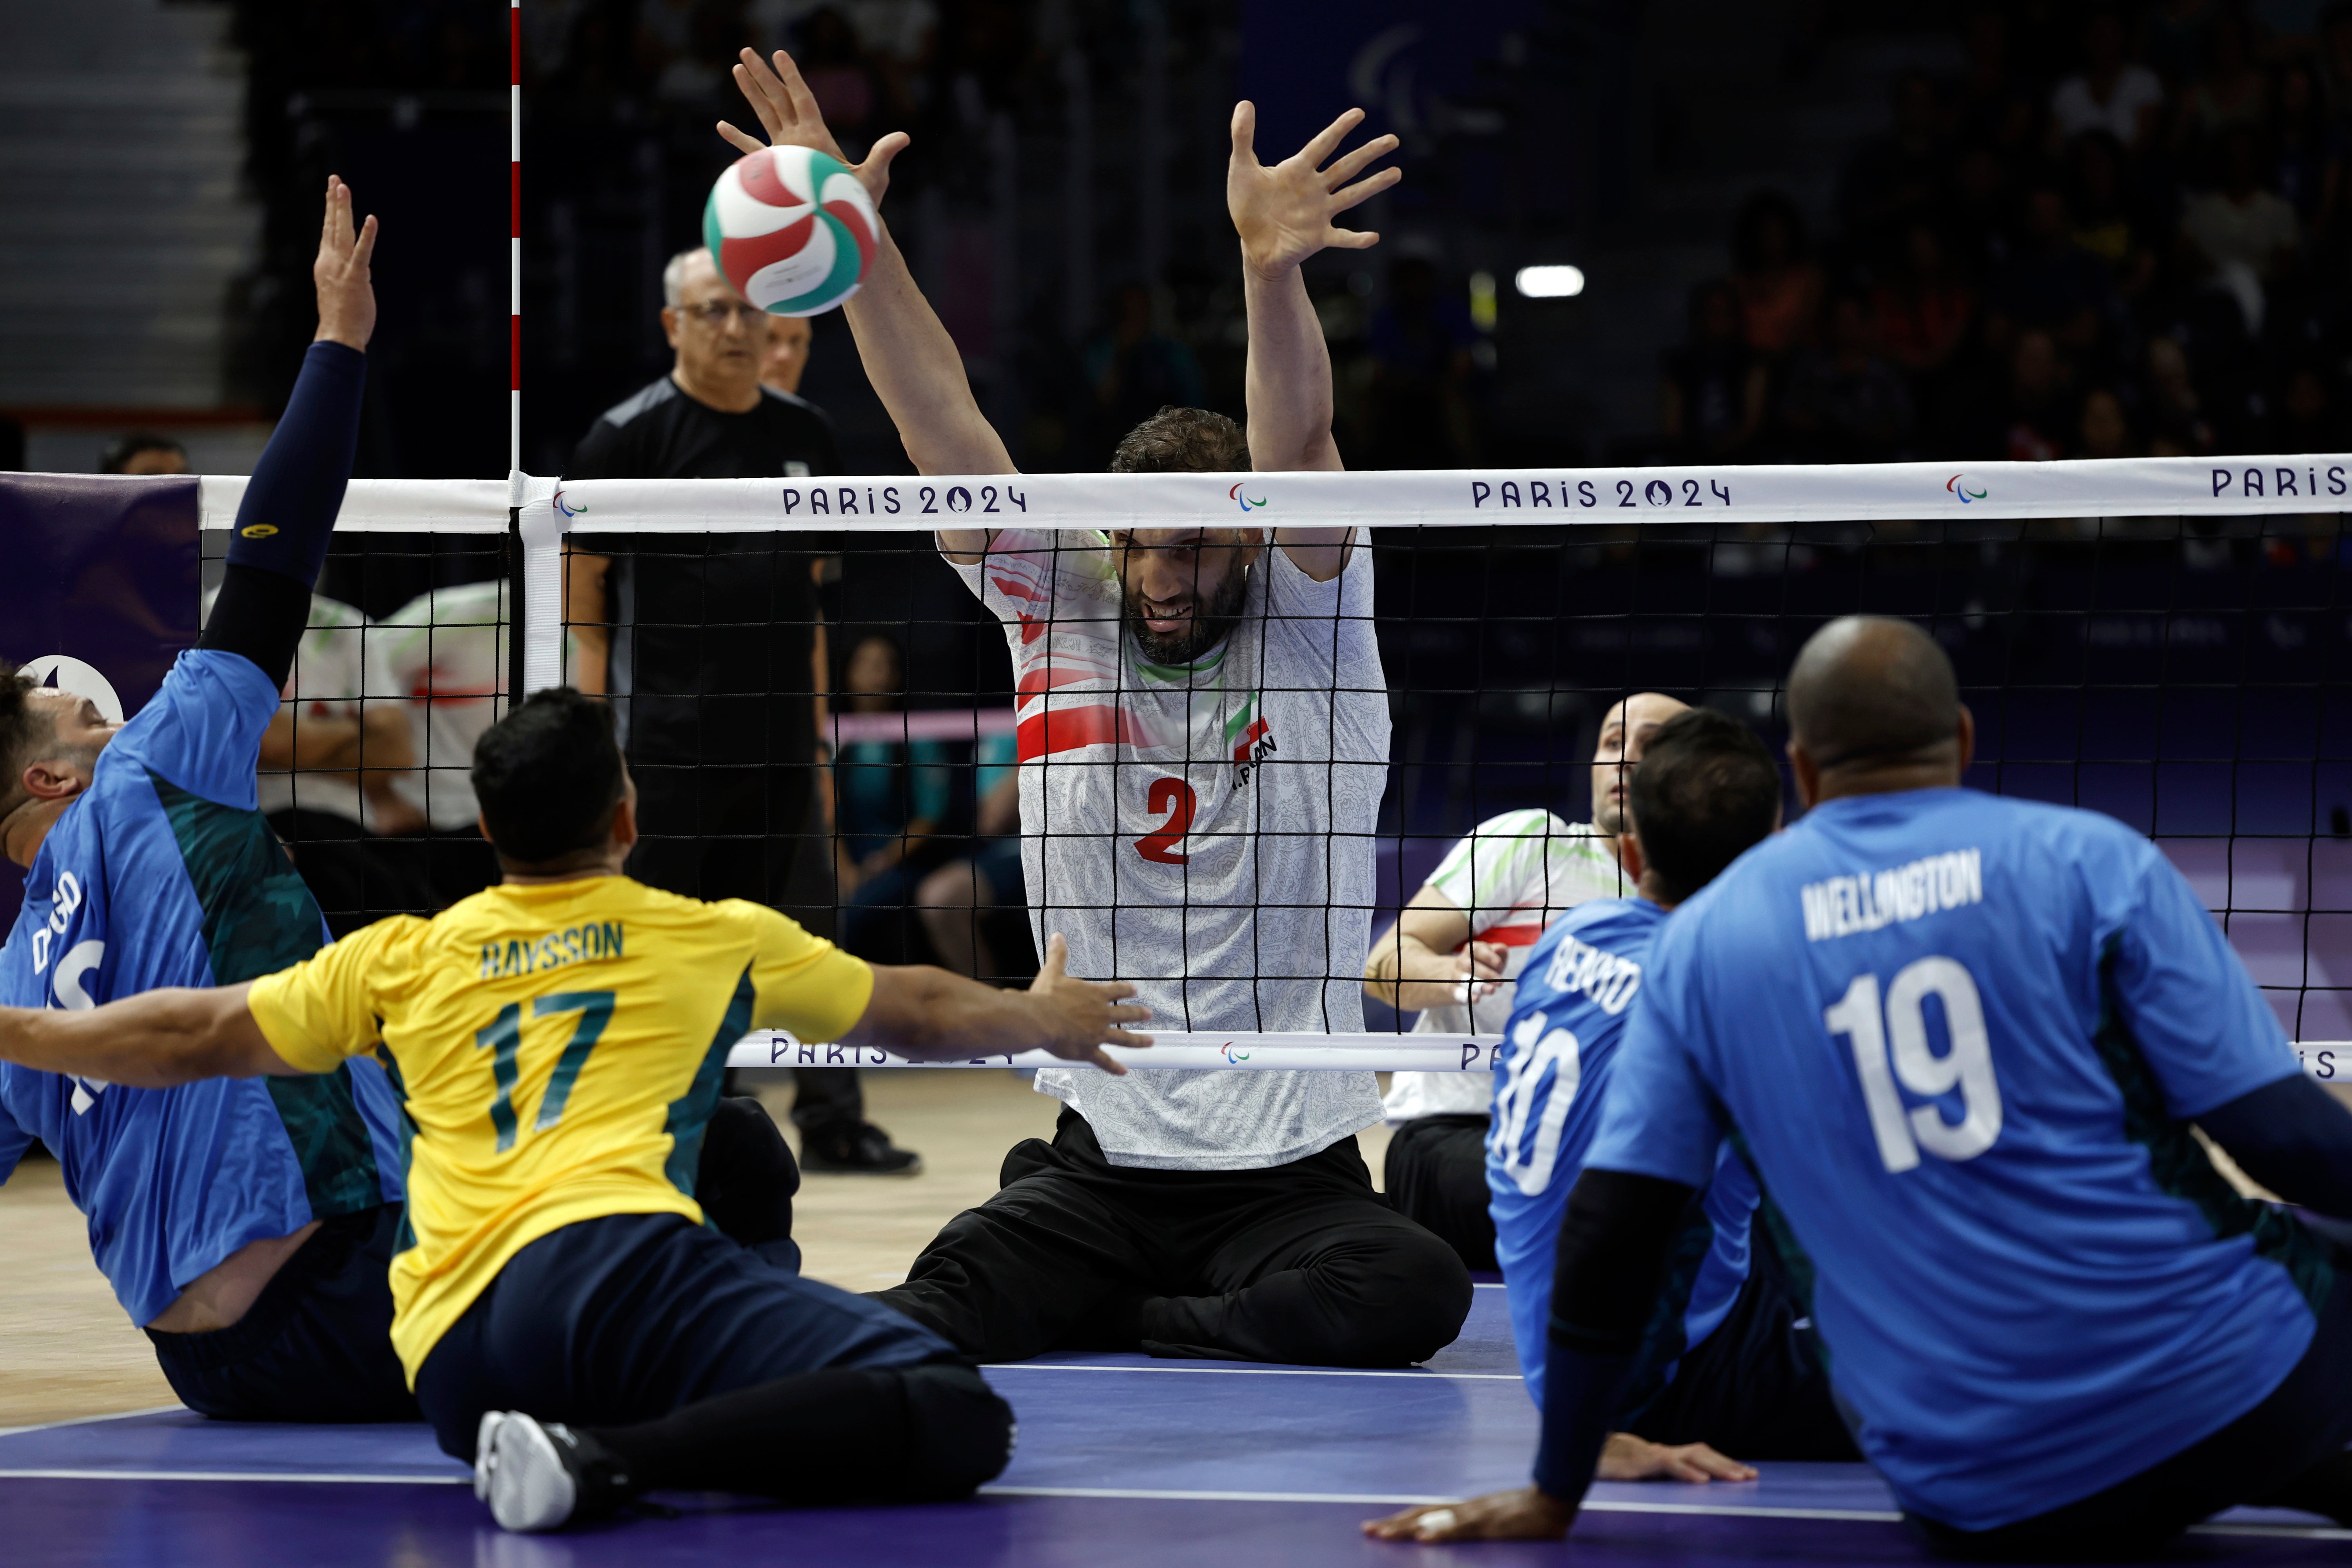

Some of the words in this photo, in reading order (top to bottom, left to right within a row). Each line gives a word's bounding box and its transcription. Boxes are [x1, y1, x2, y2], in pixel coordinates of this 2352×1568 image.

[919, 486, 1026, 513] 2024
[1616, 479, 1730, 507] 2024
[1133, 777, 1196, 865] 2
[475, 991, 616, 1154] 17
[1492, 1009, 1581, 1197] 10
[1823, 954, 2004, 1174] 19
